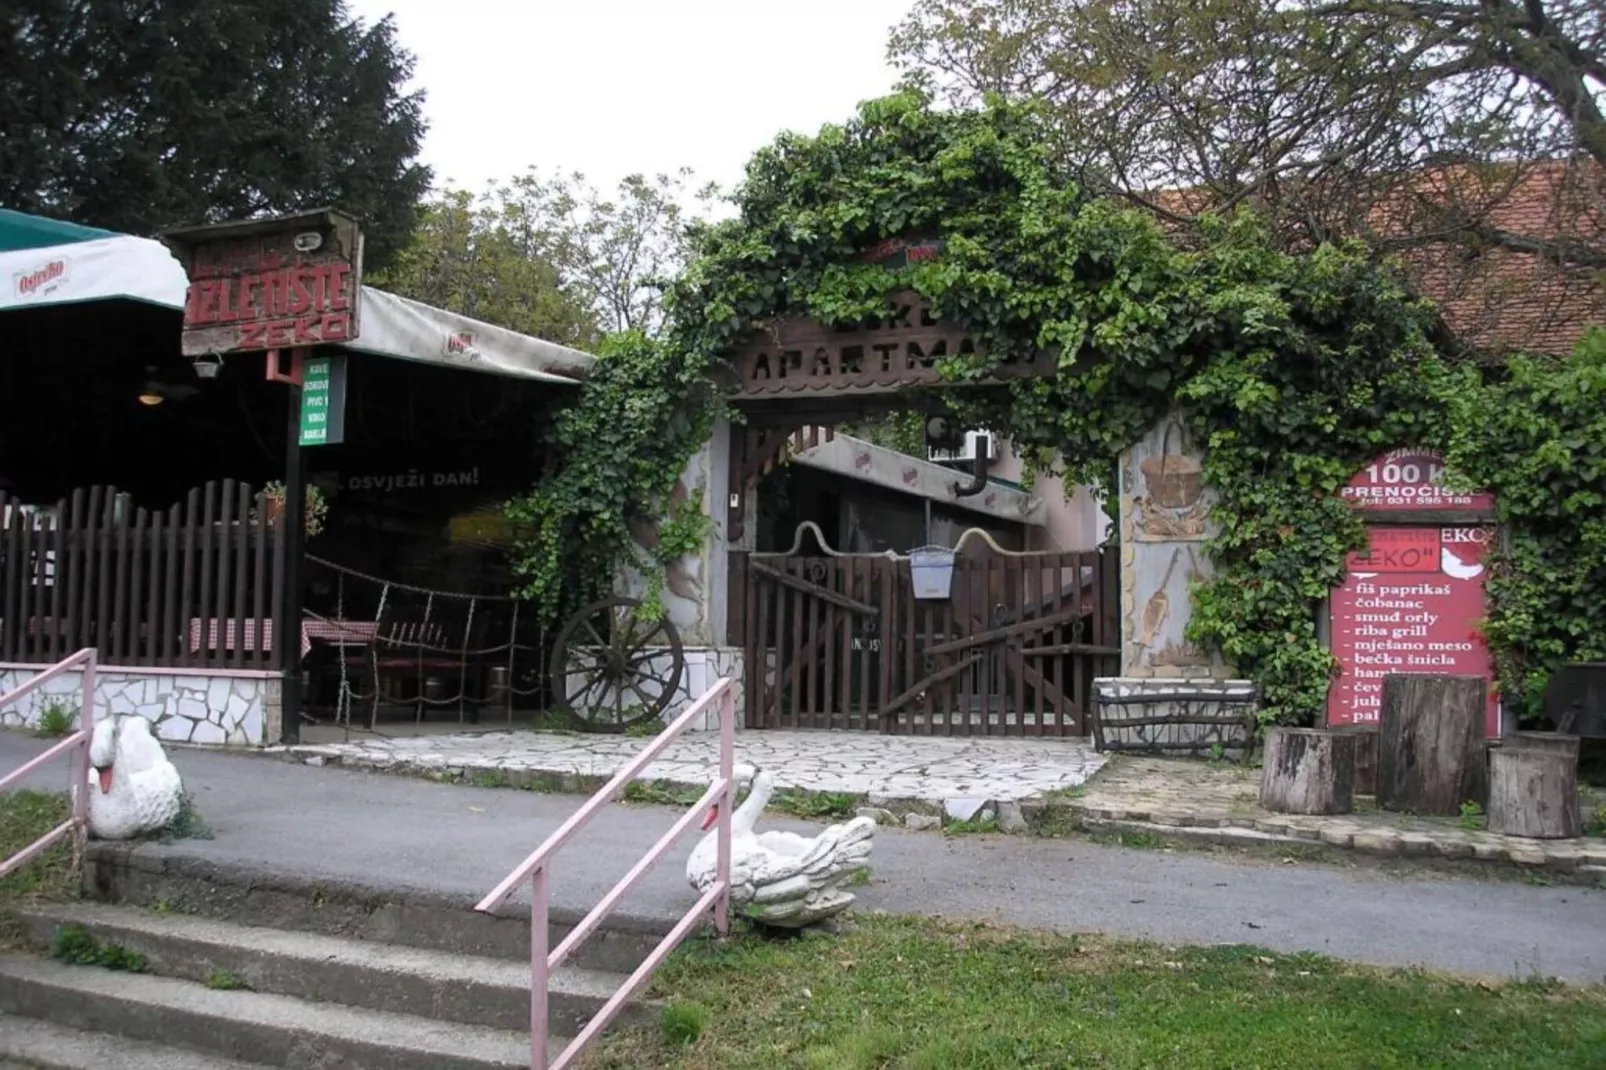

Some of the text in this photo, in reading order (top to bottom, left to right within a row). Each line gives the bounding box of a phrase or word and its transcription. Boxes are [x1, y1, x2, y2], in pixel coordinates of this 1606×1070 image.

[240, 313, 349, 349] ZEKO
[1385, 446, 1444, 464] ZIMME
[348, 466, 479, 492] OSVJEŽI DAN!
[1366, 464, 1420, 483] 100
[1341, 484, 1483, 497] PRENOĆI
[1441, 528, 1485, 543] EKO
[1355, 583, 1450, 597] fiš paprikaš
[1354, 597, 1424, 609] čobanac
[1405, 612, 1438, 625] orly
[1354, 625, 1427, 639] riba grill
[1354, 639, 1472, 652] mješano meso
[1354, 653, 1456, 665] bečka šnicla
